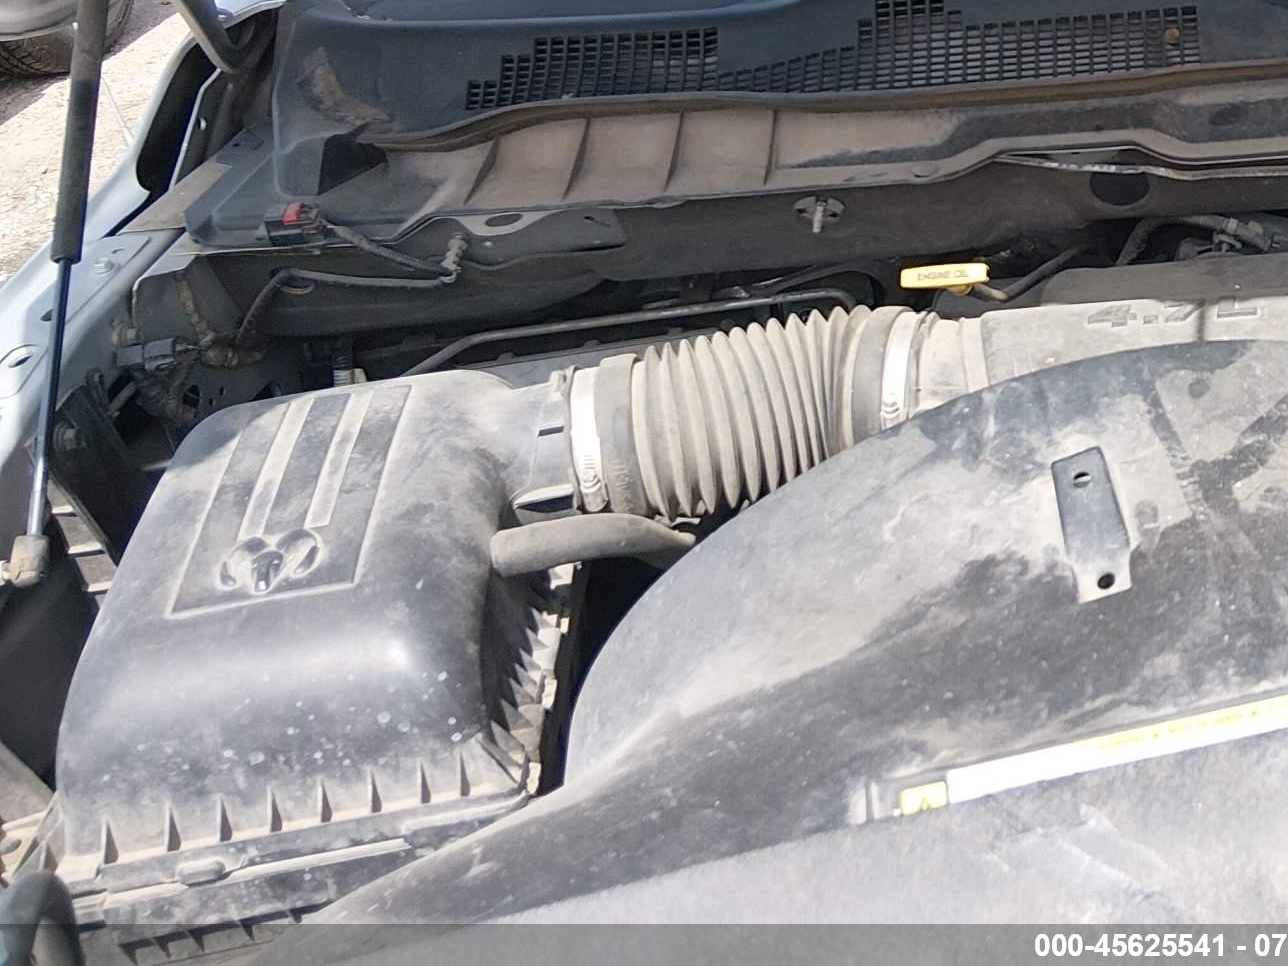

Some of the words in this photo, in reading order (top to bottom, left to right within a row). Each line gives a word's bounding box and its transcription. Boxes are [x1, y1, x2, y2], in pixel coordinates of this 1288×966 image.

[917, 270, 952, 281] ENGINE
[953, 269, 969, 278] OIL
[1087, 293, 1260, 327] 4.7L
